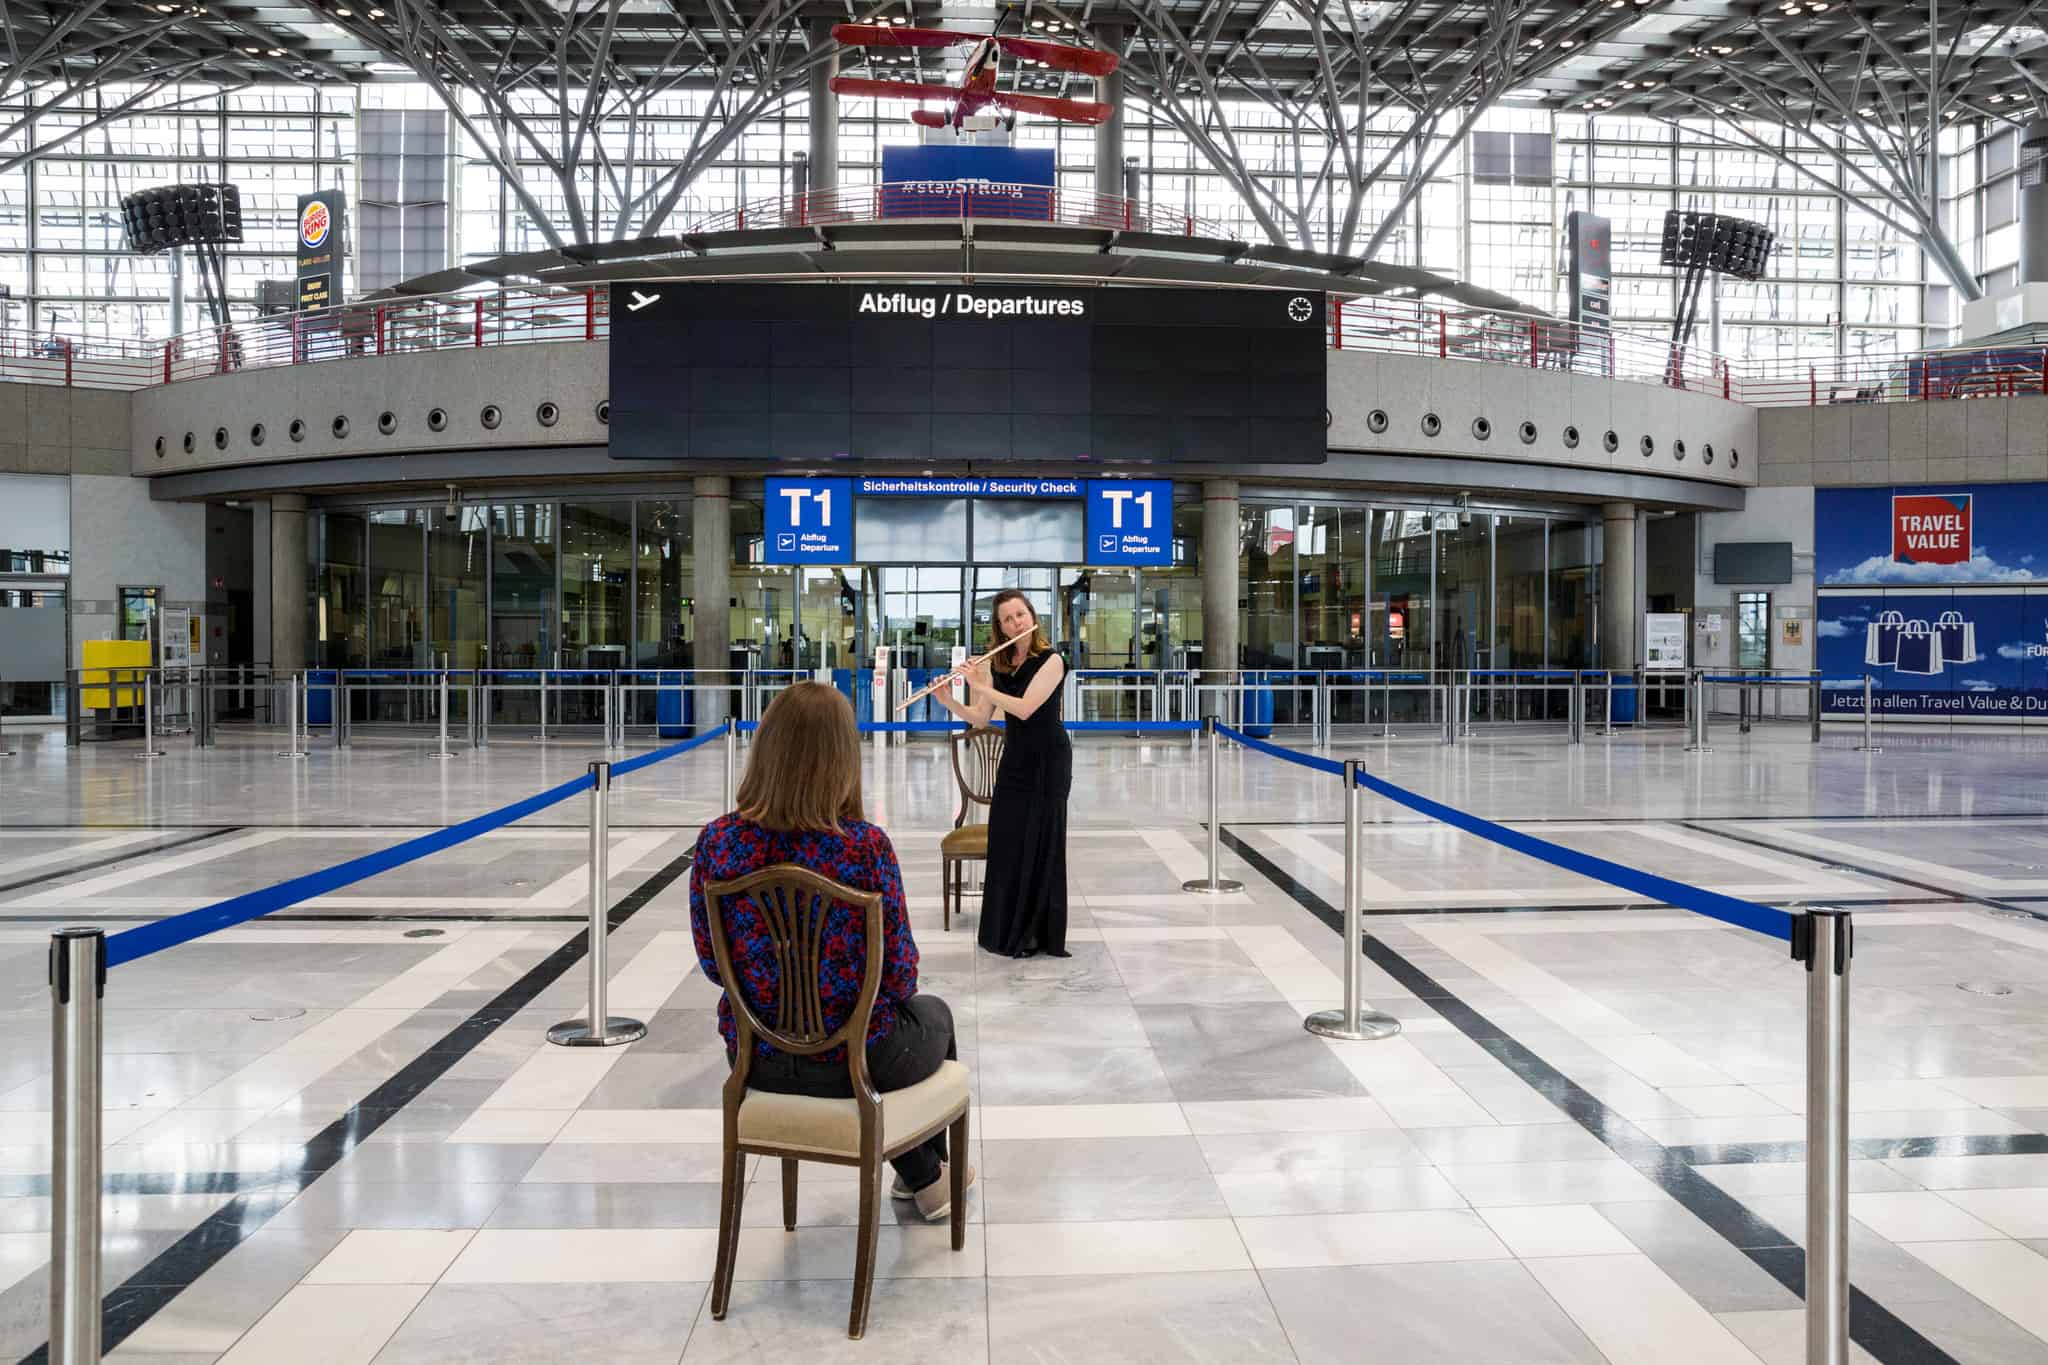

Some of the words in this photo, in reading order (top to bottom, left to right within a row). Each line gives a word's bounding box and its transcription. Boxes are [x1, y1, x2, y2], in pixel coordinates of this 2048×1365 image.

[303, 216, 328, 239] KING
[859, 293, 936, 318] Abflug
[941, 294, 951, 313] /
[956, 294, 1085, 318] Departures
[863, 481, 980, 492] Sicherheitskontrolle
[982, 482, 987, 492] /
[989, 482, 1037, 495] Security
[1040, 483, 1077, 493] Check
[780, 488, 831, 527] T1
[1102, 490, 1153, 529] T1
[1900, 514, 1964, 532] TRAVEL
[800, 533, 827, 543] Abflug
[1122, 535, 1148, 545] Abflug
[1906, 533, 1960, 549] VALUE
[800, 544, 840, 553] Departure
[1122, 545, 1160, 554] Departure
[1831, 694, 1865, 708] Jetzt
[1883, 694, 1917, 709] allen
[1919, 694, 1965, 709] Travel
[1968, 695, 2007, 710] Value
[2009, 696, 2023, 710] &
